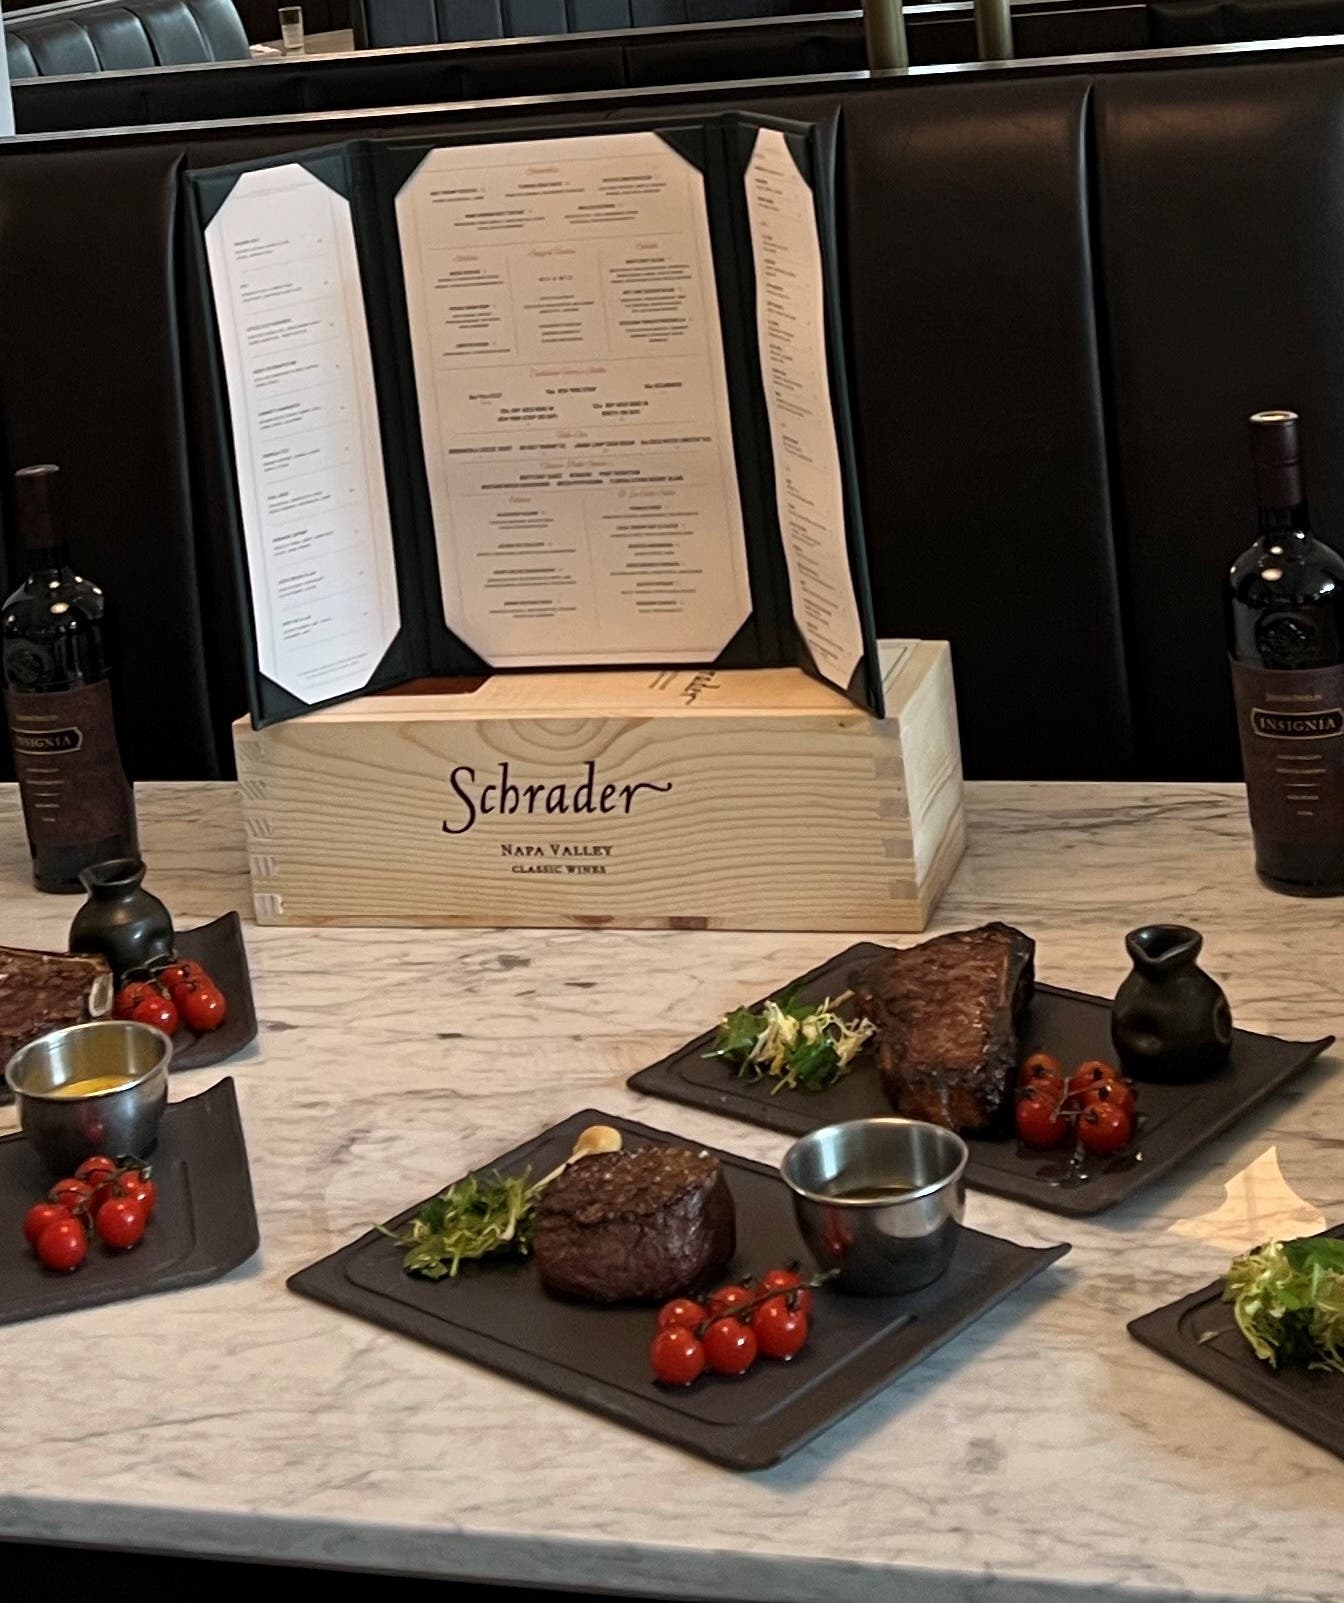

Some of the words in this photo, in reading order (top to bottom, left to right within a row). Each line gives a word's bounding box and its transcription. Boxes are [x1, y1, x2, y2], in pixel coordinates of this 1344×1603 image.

[1259, 717, 1337, 732] INSIGNIA
[441, 760, 673, 834] Schrader
[500, 843, 545, 857] NAPA
[550, 843, 614, 857] VALLEY
